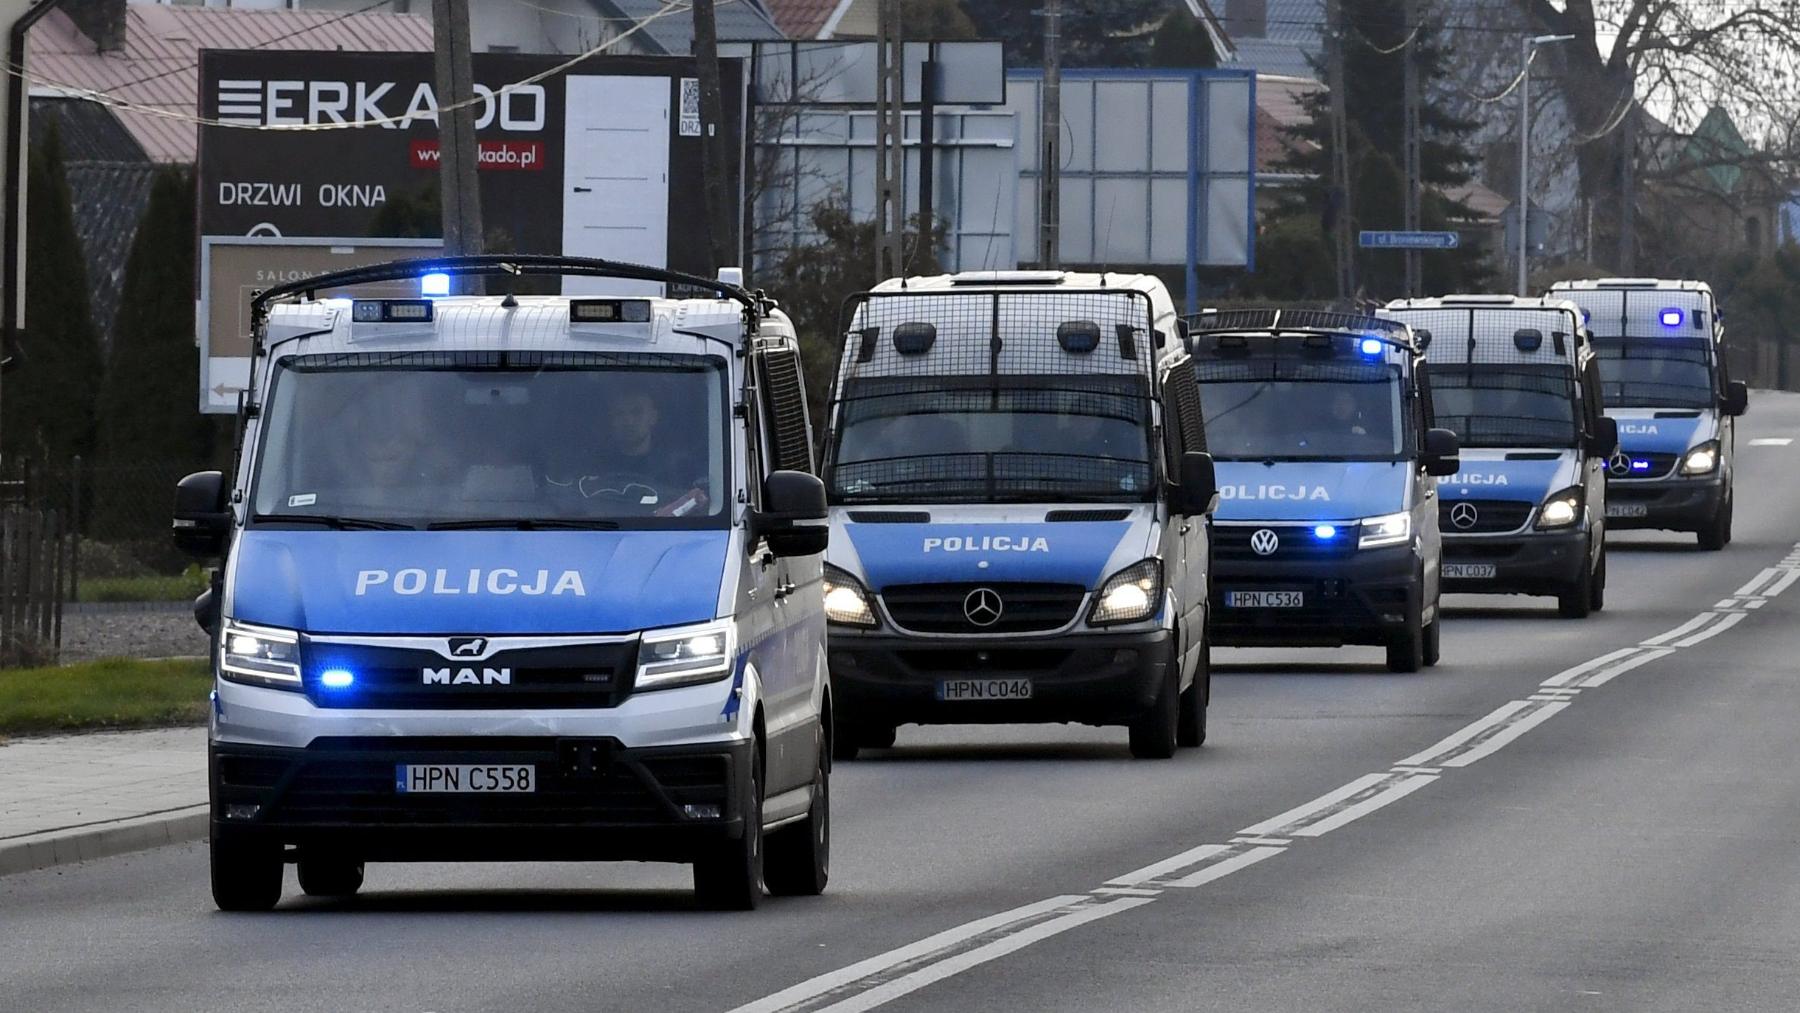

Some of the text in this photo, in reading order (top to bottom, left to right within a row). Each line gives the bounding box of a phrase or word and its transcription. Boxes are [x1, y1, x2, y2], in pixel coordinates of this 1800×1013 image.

[218, 182, 386, 207] DRZWI OKNA
[256, 270, 314, 282] SALON
[1620, 425, 1658, 434] ICJA
[1437, 473, 1508, 485] OLICJA
[1219, 485, 1330, 501] OLICJA
[923, 536, 1050, 552] POLICJA
[1466, 565, 1495, 577] C037
[355, 568, 586, 596] POLICJA
[1234, 592, 1301, 606] HPN C536
[422, 667, 511, 685] MAN
[945, 680, 1029, 698] HPN C046
[412, 766, 460, 790] HPN
[469, 766, 531, 790] C558
